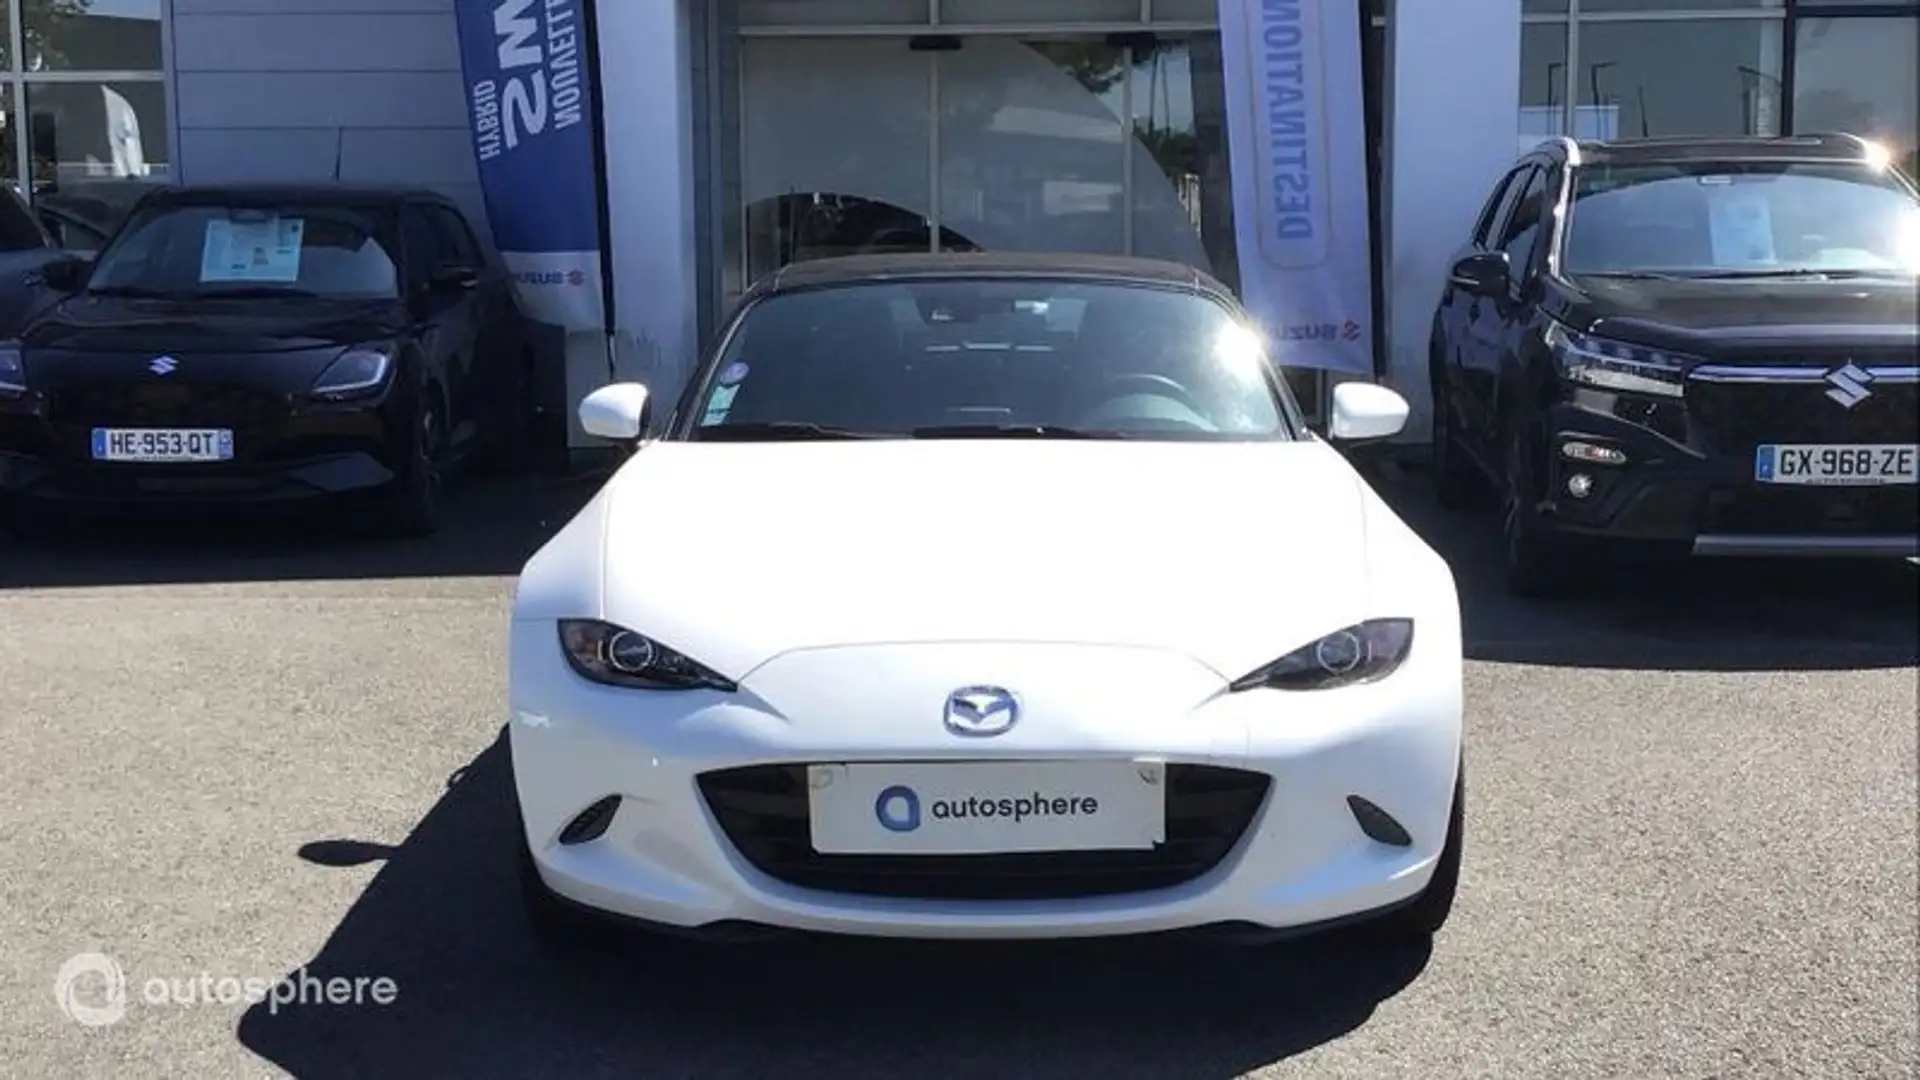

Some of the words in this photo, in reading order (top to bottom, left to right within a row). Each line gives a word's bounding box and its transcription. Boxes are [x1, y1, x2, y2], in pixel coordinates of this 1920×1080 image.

[110, 432, 215, 454] HE-953-QT
[1780, 449, 1913, 476] GX-968-ZE
[932, 791, 1098, 823] autosphere
